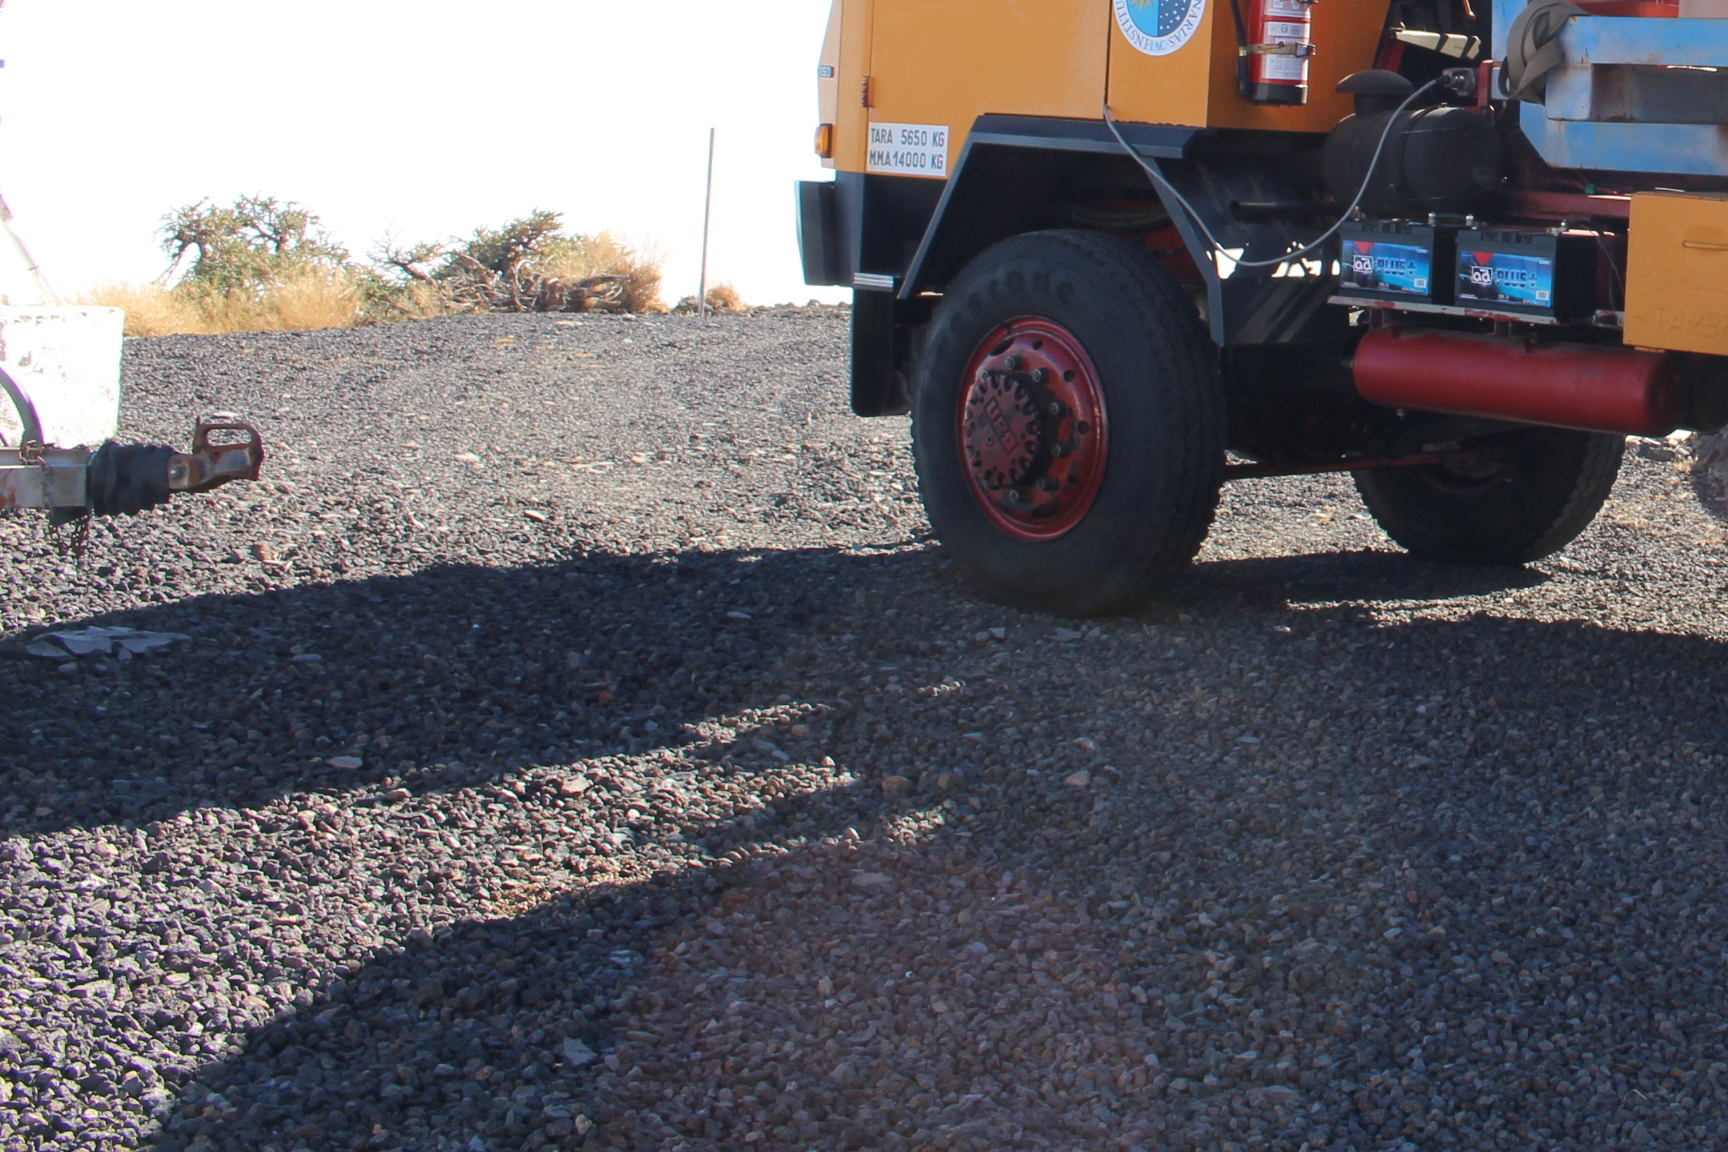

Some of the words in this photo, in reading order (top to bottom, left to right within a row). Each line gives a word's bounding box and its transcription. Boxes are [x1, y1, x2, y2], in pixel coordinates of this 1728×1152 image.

[870, 127, 893, 144] TARA
[901, 128, 928, 146] 5650
[932, 131, 945, 148] KG
[892, 150, 926, 169] 14000
[930, 153, 944, 170] KG
